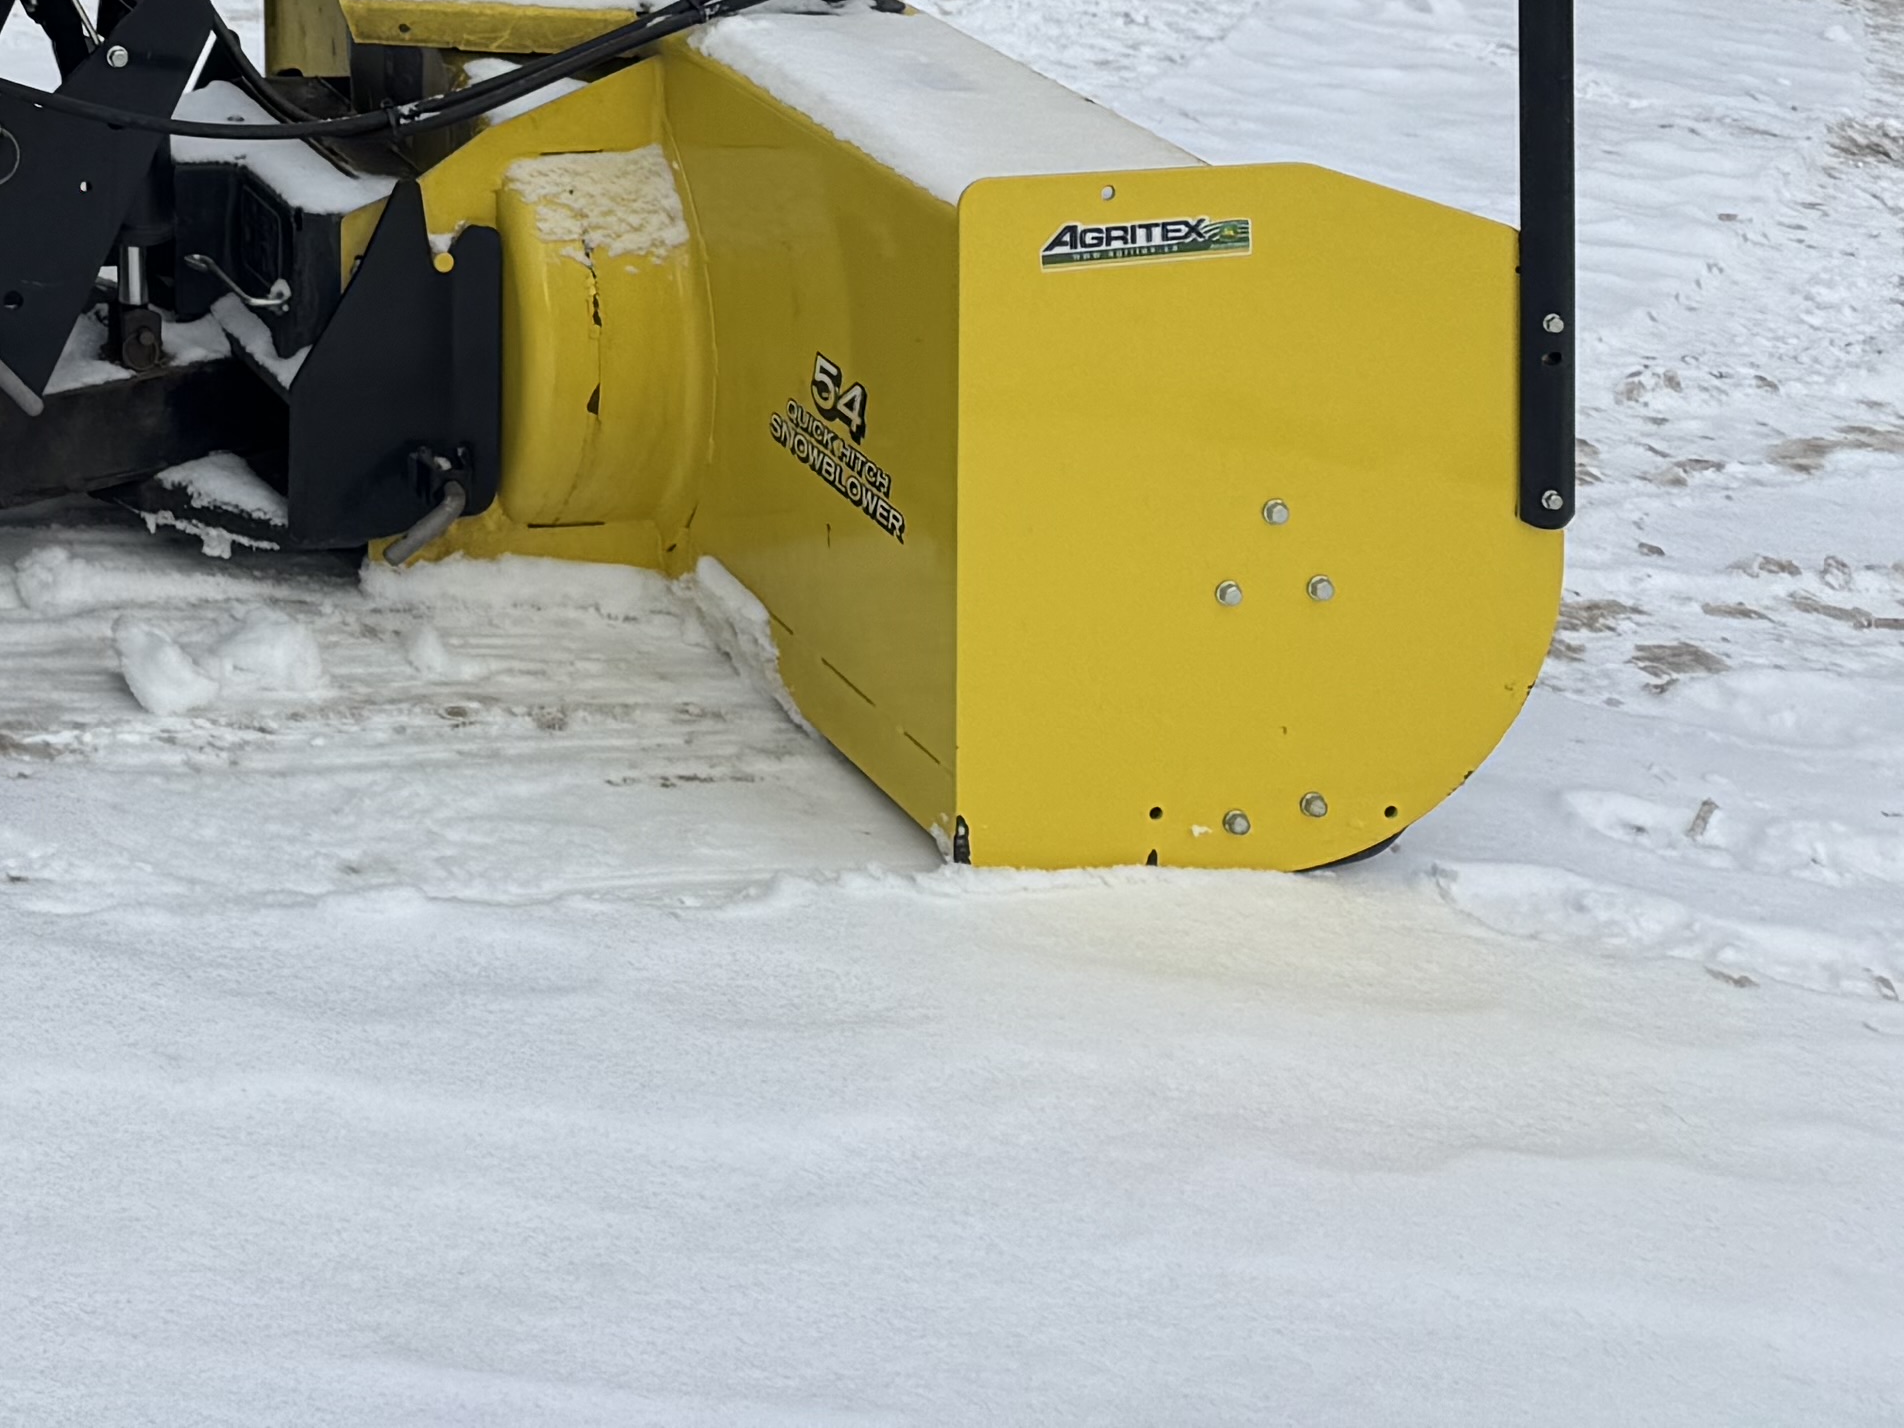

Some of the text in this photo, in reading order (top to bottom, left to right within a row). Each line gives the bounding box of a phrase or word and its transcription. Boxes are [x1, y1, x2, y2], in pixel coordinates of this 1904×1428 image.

[1042, 218, 1208, 253] AGRITEX
[812, 351, 867, 444] 54
[770, 412, 905, 544] SNOWBLOWER
[786, 398, 891, 498] QUICK HITCH
